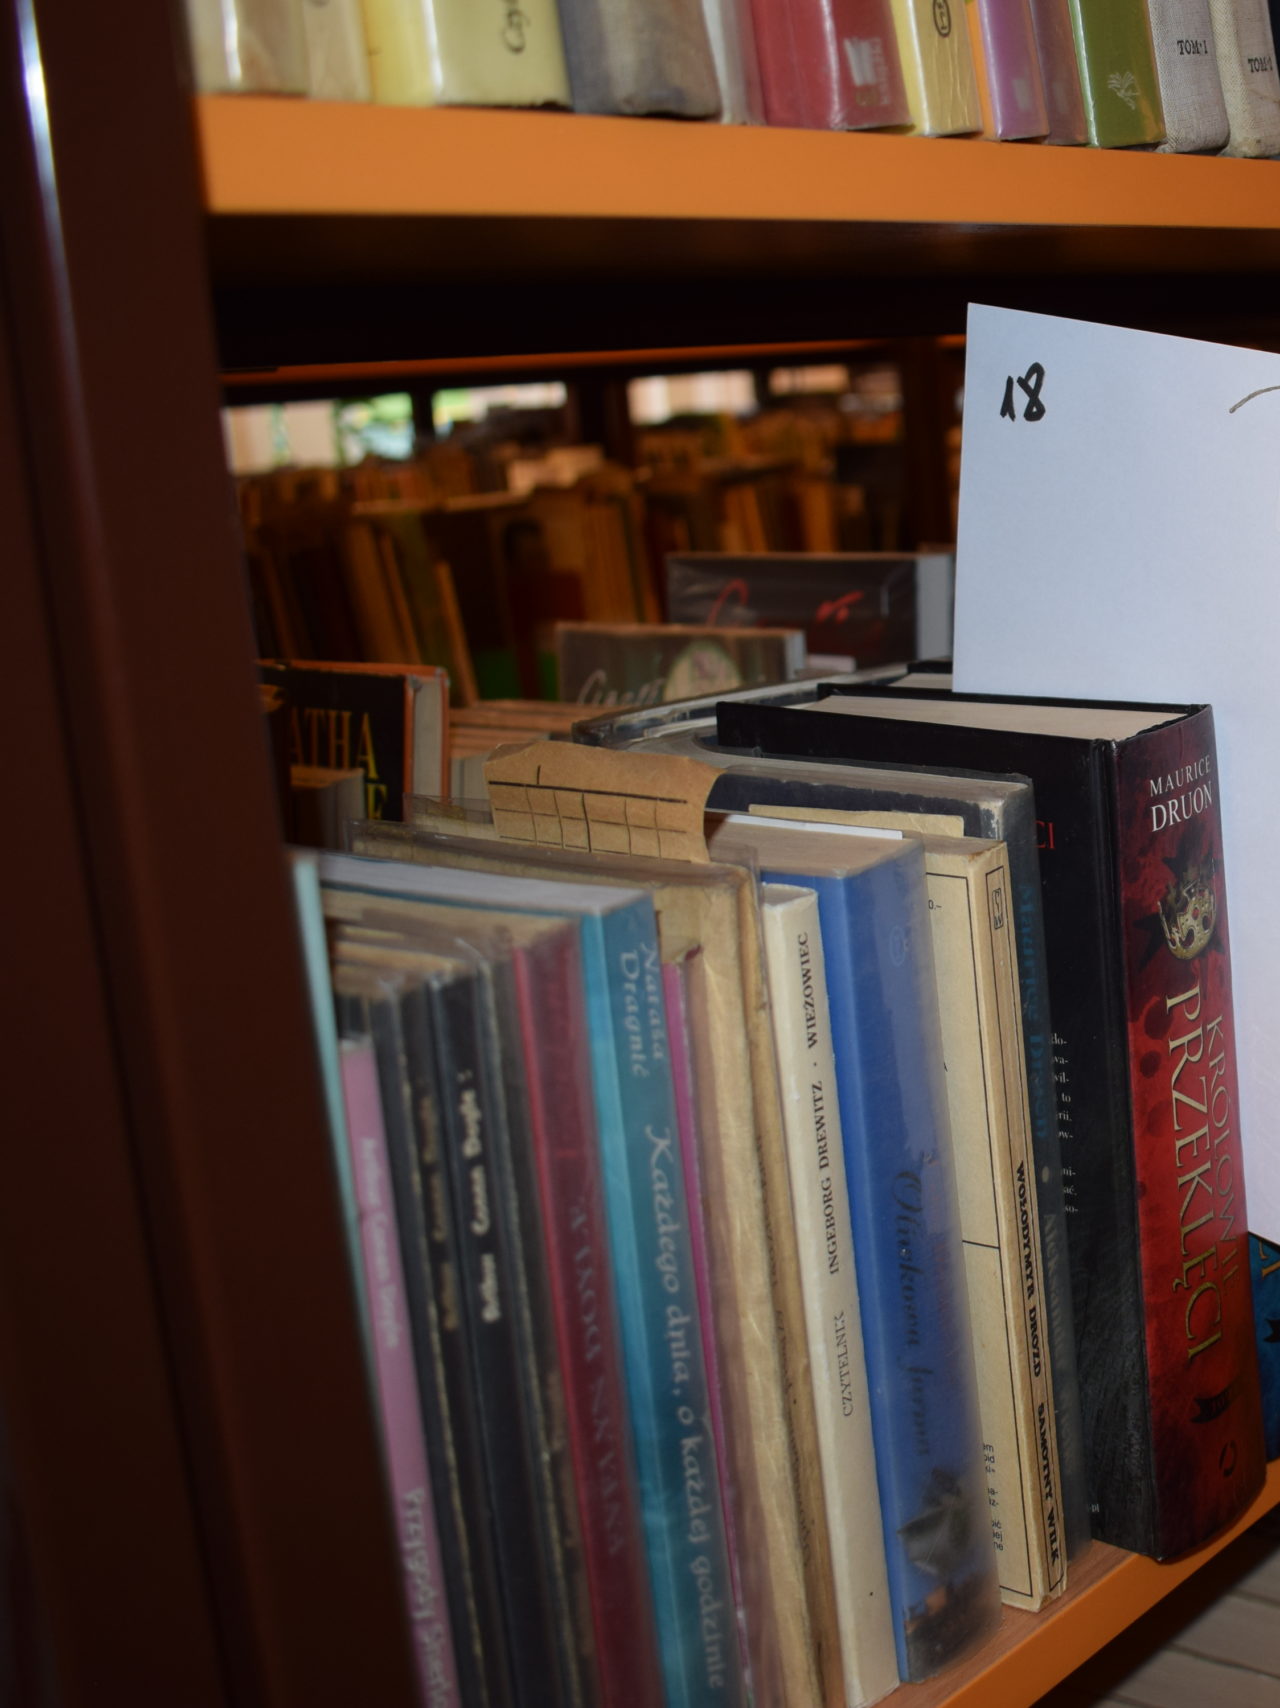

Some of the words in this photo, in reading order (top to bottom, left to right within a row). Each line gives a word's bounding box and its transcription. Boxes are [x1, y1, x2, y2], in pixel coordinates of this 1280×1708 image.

[1000, 362, 1046, 422] 18
[1150, 754, 1211, 798] MAURICE
[1151, 780, 1214, 832] DRUON
[812, 1080, 830, 1170] DREWITZ
[1166, 987, 1223, 1360] PRZEKLĘCI
[821, 1177, 839, 1275] INGEBORG
[833, 1309, 854, 1417] CZYTELNIK
[1028, 1307, 1043, 1378] DROZD
[1037, 1403, 1054, 1502] SAMOTNY
[1045, 1506, 1060, 1567] WILK
